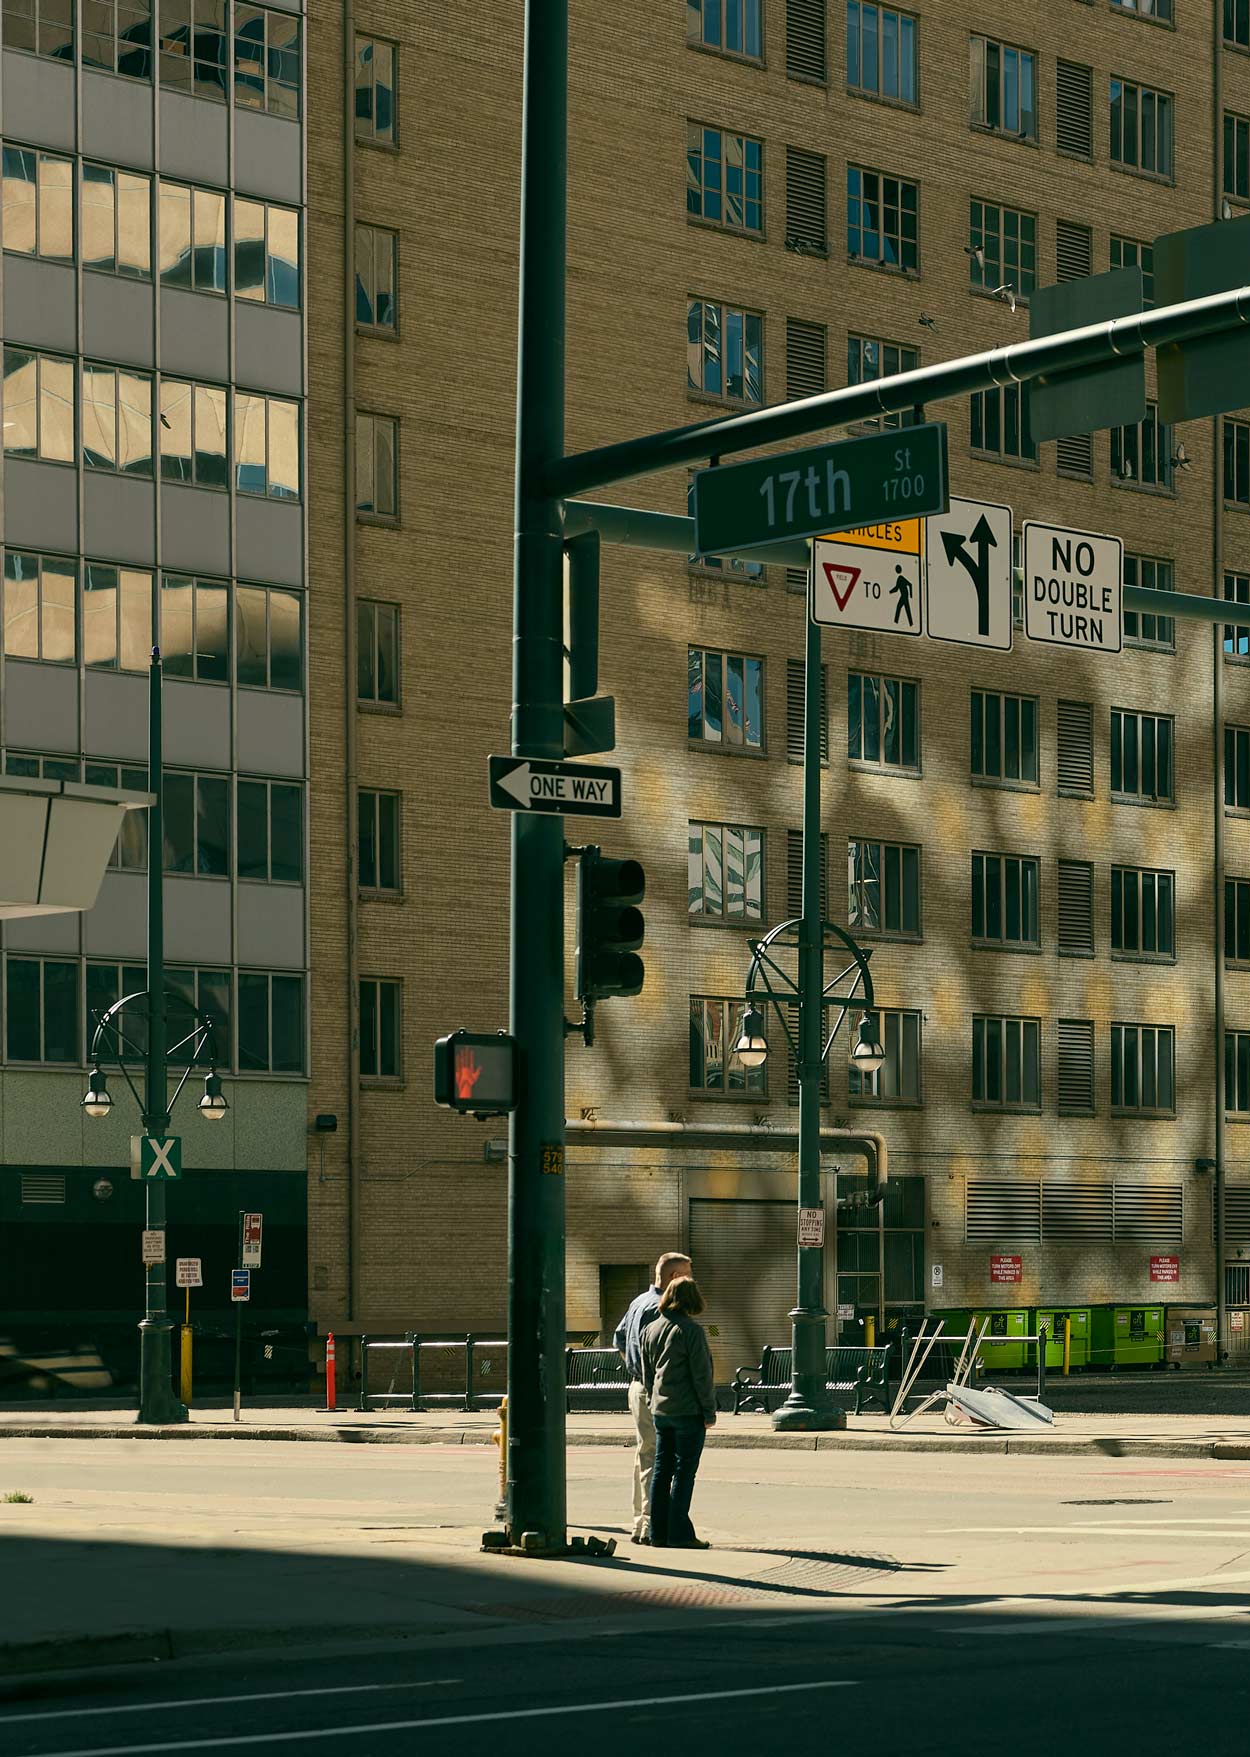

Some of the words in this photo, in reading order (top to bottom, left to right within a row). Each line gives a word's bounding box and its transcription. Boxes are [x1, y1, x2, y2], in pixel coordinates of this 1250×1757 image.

[759, 459, 851, 526] 17th
[894, 447, 911, 470] St
[883, 474, 925, 500] 1700
[843, 524, 902, 542] ICLES
[1052, 536, 1095, 577] NO
[863, 581, 881, 599] TO
[1034, 576, 1113, 613] DOUBLE
[1046, 610, 1104, 644] TURN
[530, 776, 566, 798] ONE
[572, 779, 608, 801] WAY
[147, 1139, 177, 1176] X
[543, 1151, 563, 1163] 579
